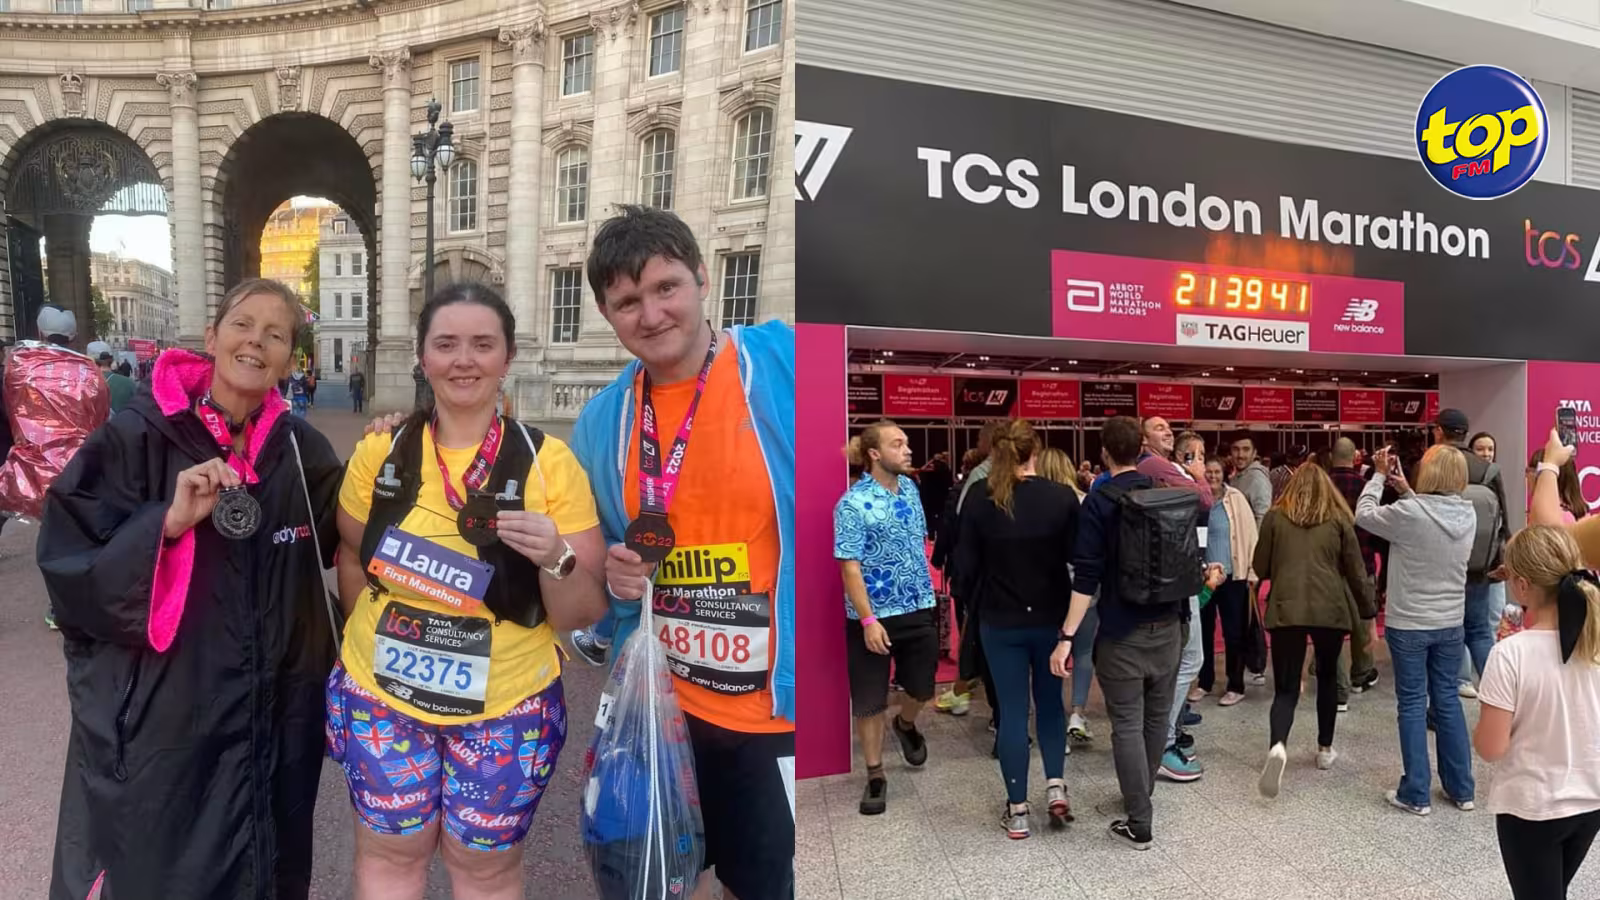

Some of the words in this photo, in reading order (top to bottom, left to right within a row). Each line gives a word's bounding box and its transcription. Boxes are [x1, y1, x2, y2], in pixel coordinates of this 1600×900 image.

[917, 146, 1040, 209] TCS
[1062, 165, 1261, 235] London
[1279, 195, 1490, 259] Marathon
[1523, 219, 1581, 269] tcs
[1109, 283, 1144, 293] ABBOTT
[1109, 291, 1142, 300] WORLD
[1109, 299, 1162, 310] MARATHON
[1109, 307, 1147, 317] MAJORS
[1575, 416, 1600, 428] NSUL
[666, 443, 686, 475] 2022
[399, 543, 473, 591] Laura
[658, 549, 737, 583] hillip
[383, 567, 408, 584] First
[408, 576, 463, 606] Marathon
[673, 585, 736, 599] Marathon
[695, 600, 761, 612] CONSULTANCY
[695, 609, 736, 619] SERVICES
[386, 607, 423, 640] tcs
[427, 617, 452, 627] TATA
[424, 634, 462, 648] SERVICES
[426, 626, 485, 641] CONSULTANCY
[659, 624, 751, 664] 48108
[385, 646, 472, 690] 22375
[692, 675, 711, 687] new
[711, 680, 755, 692] balance
[412, 698, 431, 709] new
[432, 703, 472, 715] balance
